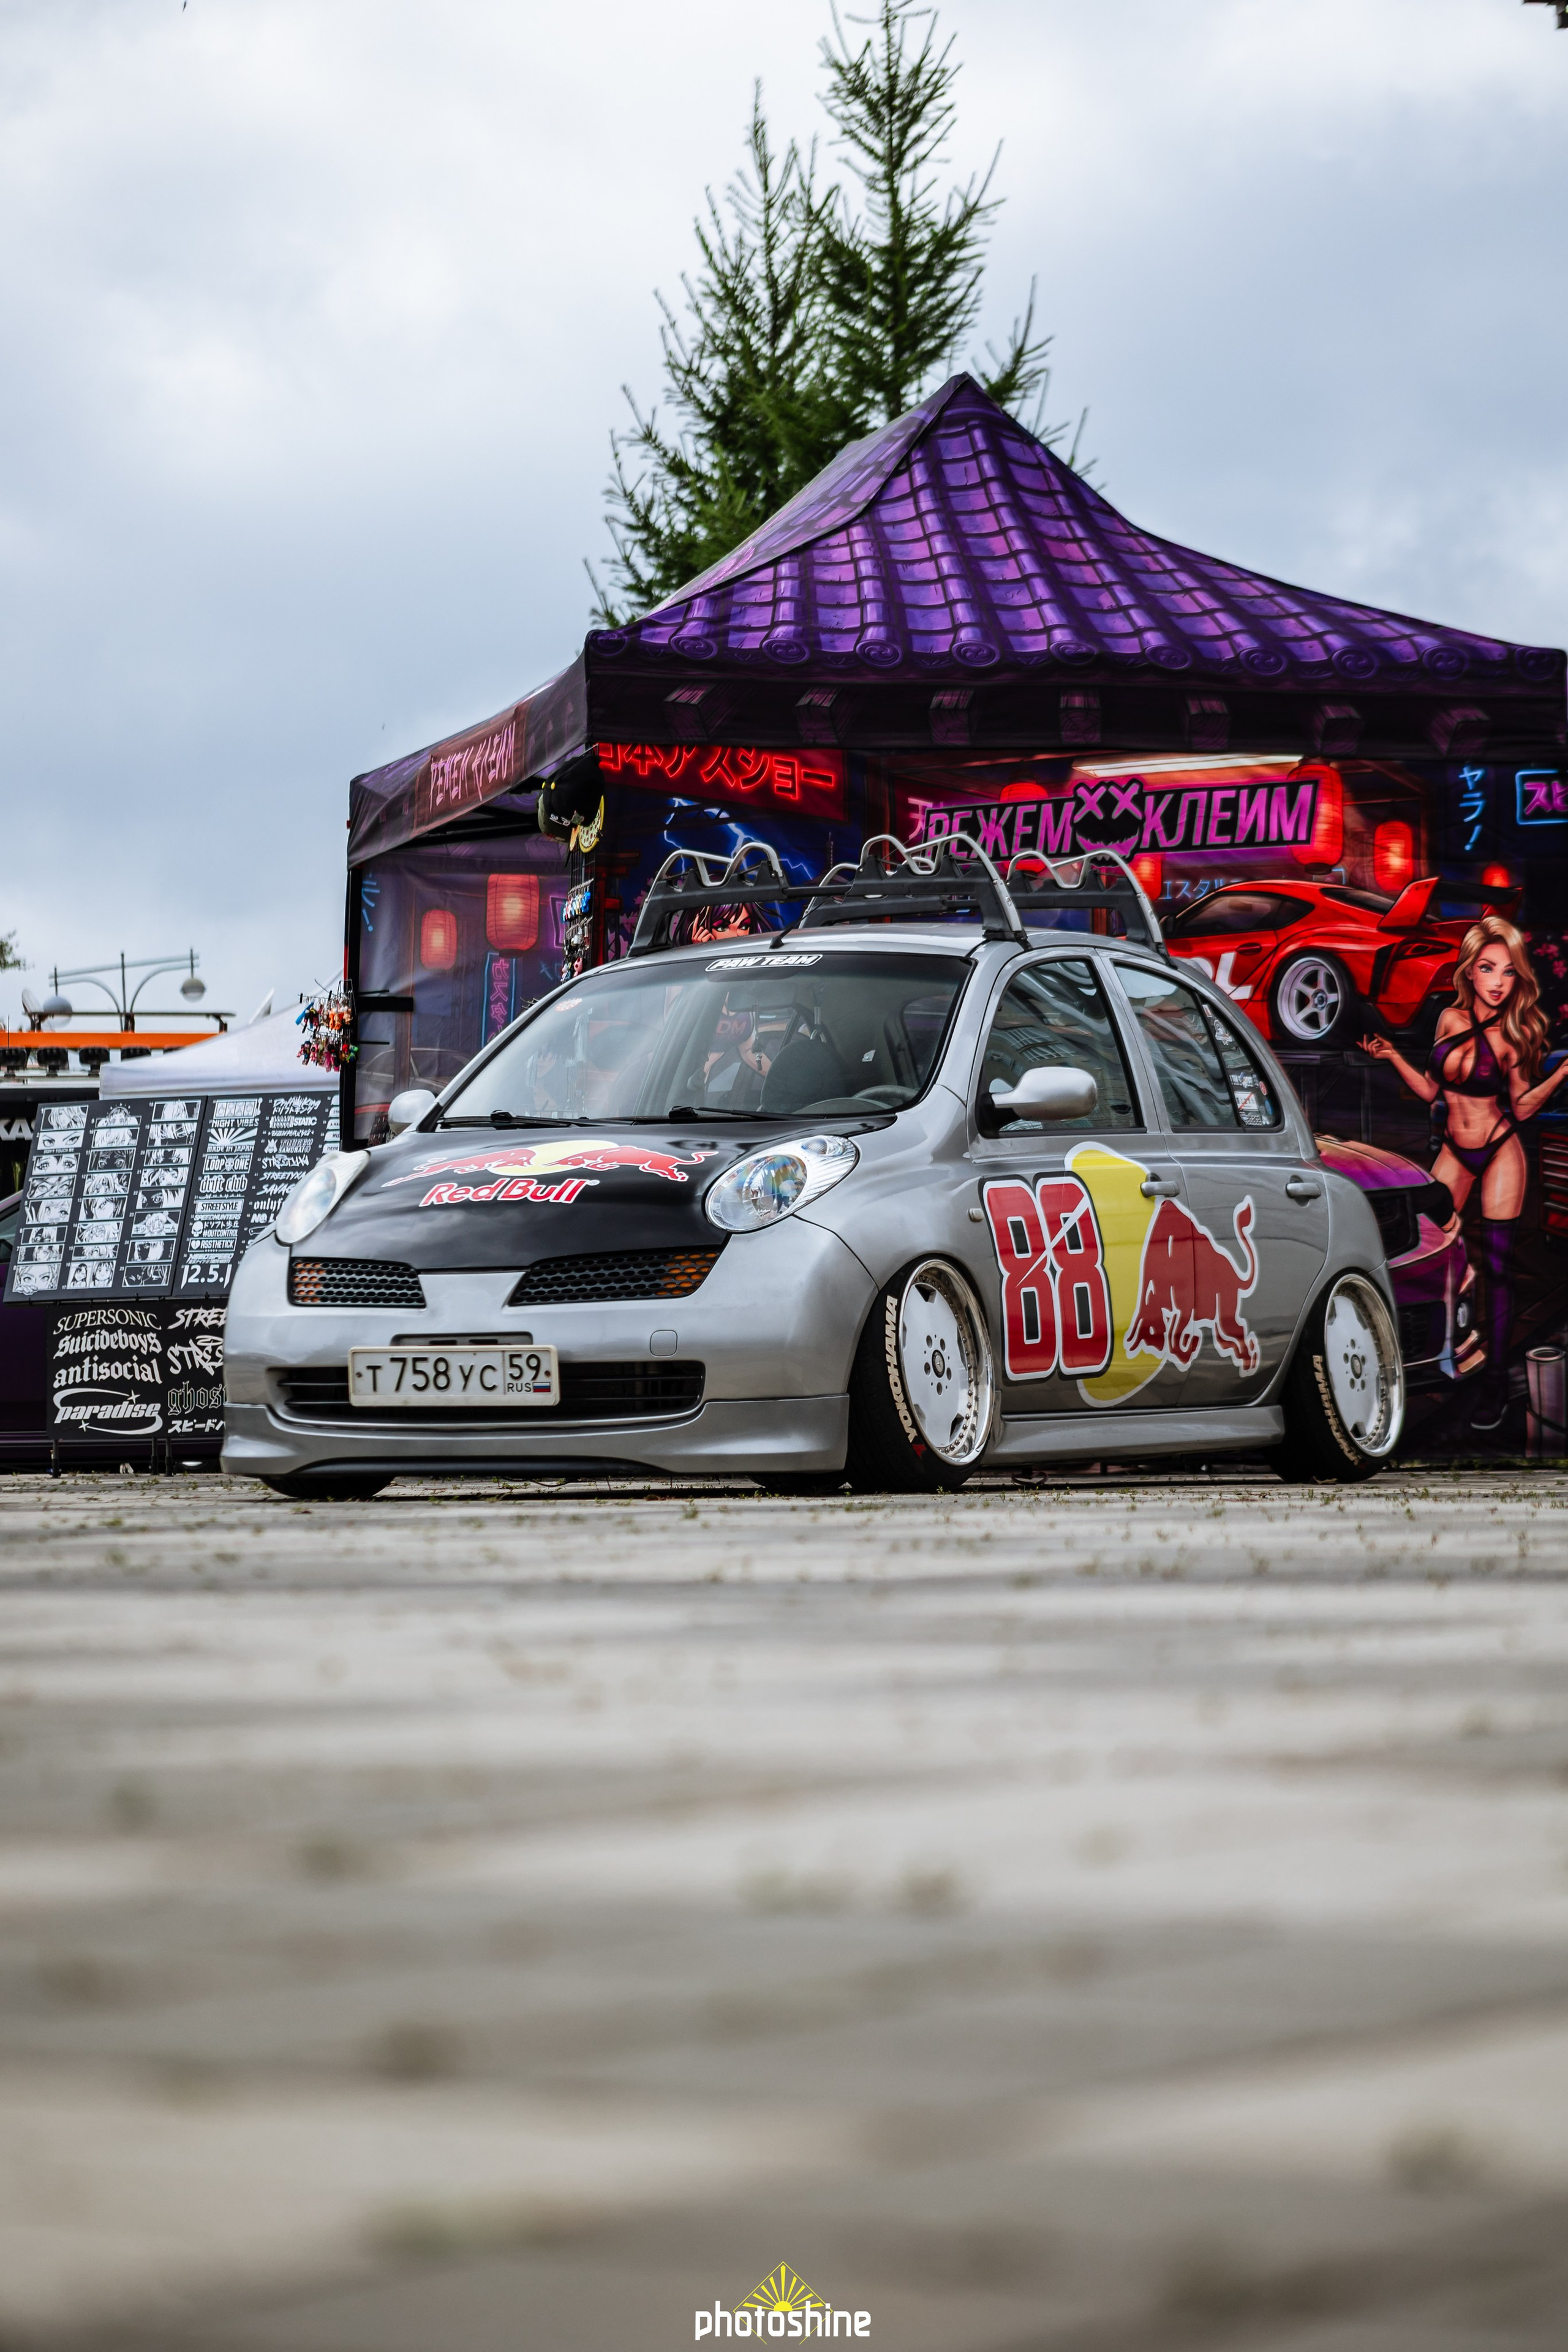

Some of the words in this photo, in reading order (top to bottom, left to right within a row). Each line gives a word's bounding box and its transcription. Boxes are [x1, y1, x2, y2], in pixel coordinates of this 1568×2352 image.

[1140, 785, 1313, 848] КЛЕИМ
[709, 957, 761, 970] PAW
[760, 956, 817, 966] TEAM
[0, 1118, 36, 1140] KA
[211, 1119, 235, 1128] NIGHT
[237, 1118, 260, 1126] VIBES
[293, 1117, 317, 1126] STATIC
[205, 1159, 225, 1170] LOOP
[234, 1158, 250, 1170] ONE
[419, 1179, 503, 1207] Red
[499, 1178, 588, 1204] Bull
[201, 1240, 235, 1249] ASSTHETICK
[982, 1176, 1112, 1381] 88
[53, 1308, 162, 1335] SUPERSONIC
[53, 1354, 162, 1389] antisocial
[508, 1353, 541, 1381] 59
[885, 1295, 918, 1444] YOKOHAMA
[168, 1381, 227, 1416] ghos
[507, 1382, 532, 1393] RUS
[54, 1400, 162, 1424] paradise
